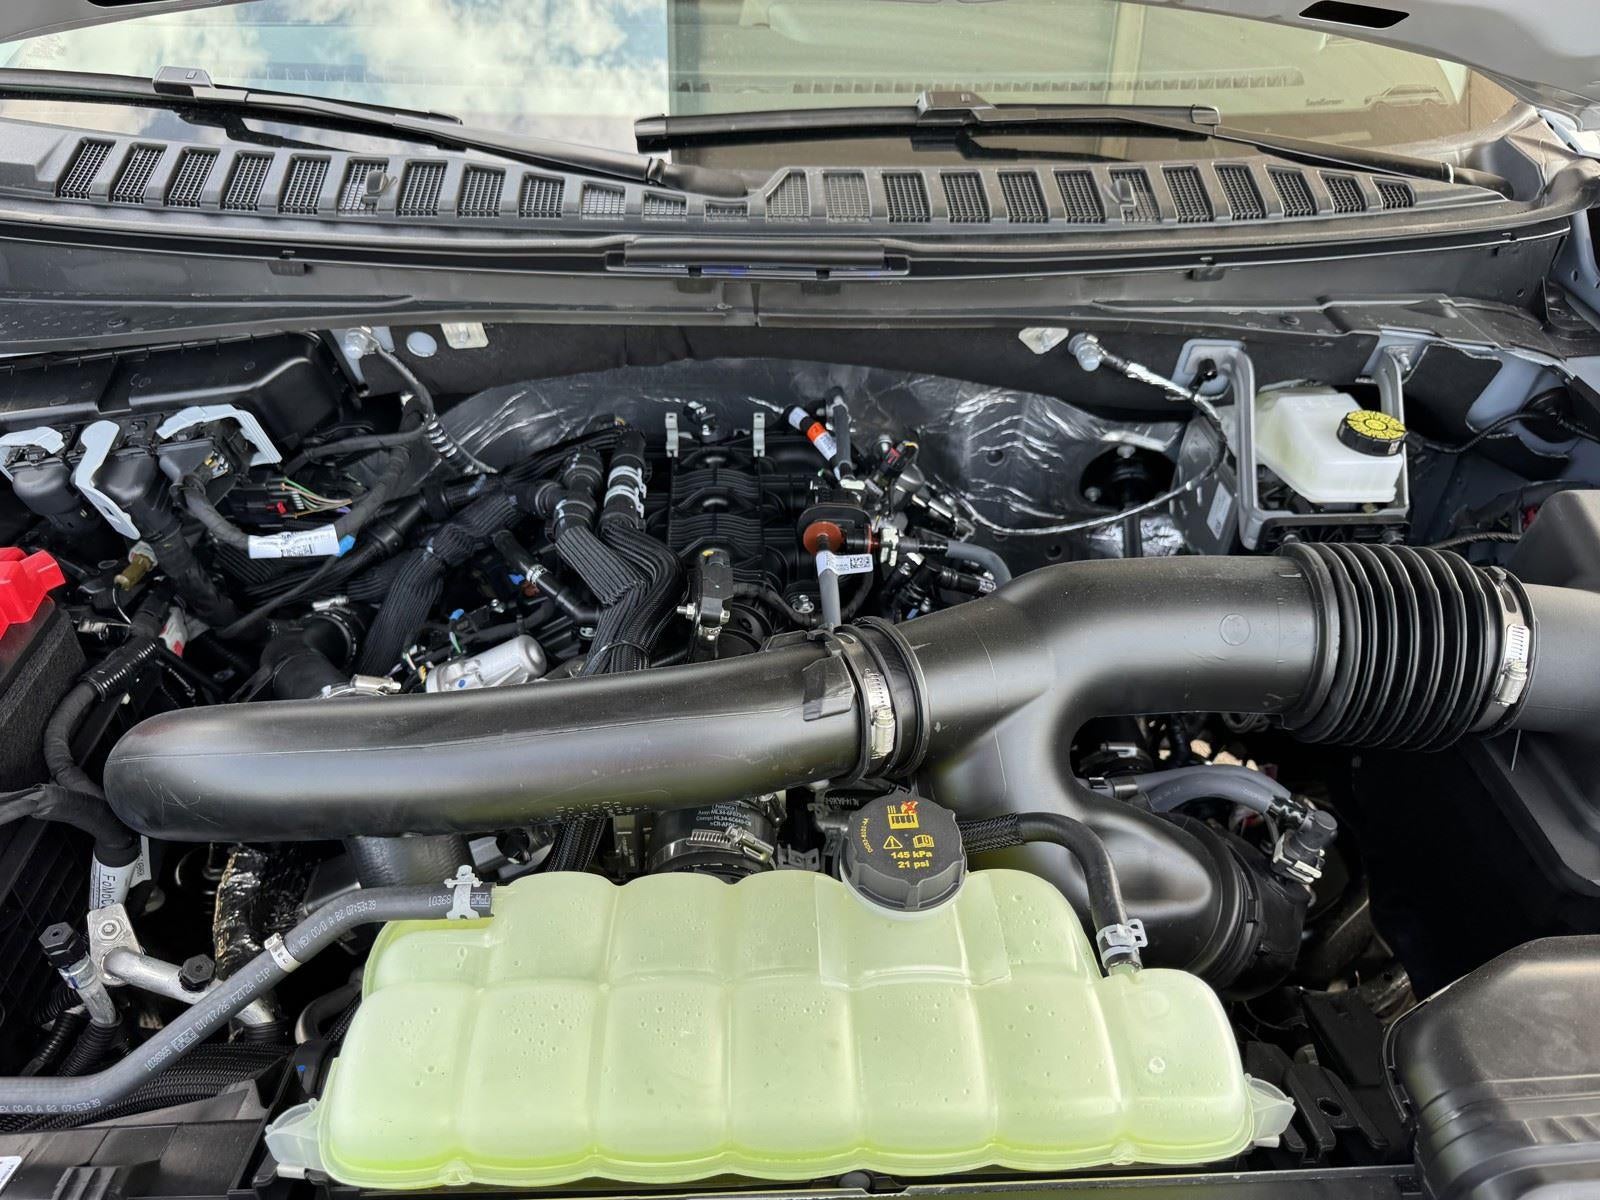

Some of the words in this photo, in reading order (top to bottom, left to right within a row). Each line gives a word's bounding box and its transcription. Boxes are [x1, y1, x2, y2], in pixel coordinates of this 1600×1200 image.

[890, 851, 911, 860] 145
[912, 850, 933, 859] kPa
[897, 861, 911, 869] 21
[913, 860, 930, 870] psi
[100, 873, 116, 910] FoMoC
[328, 915, 335, 927] A
[345, 899, 377, 917] 07:53:39
[195, 1001, 231, 1031] 01/17/26
[61, 1098, 101, 1112] 07:53:39
